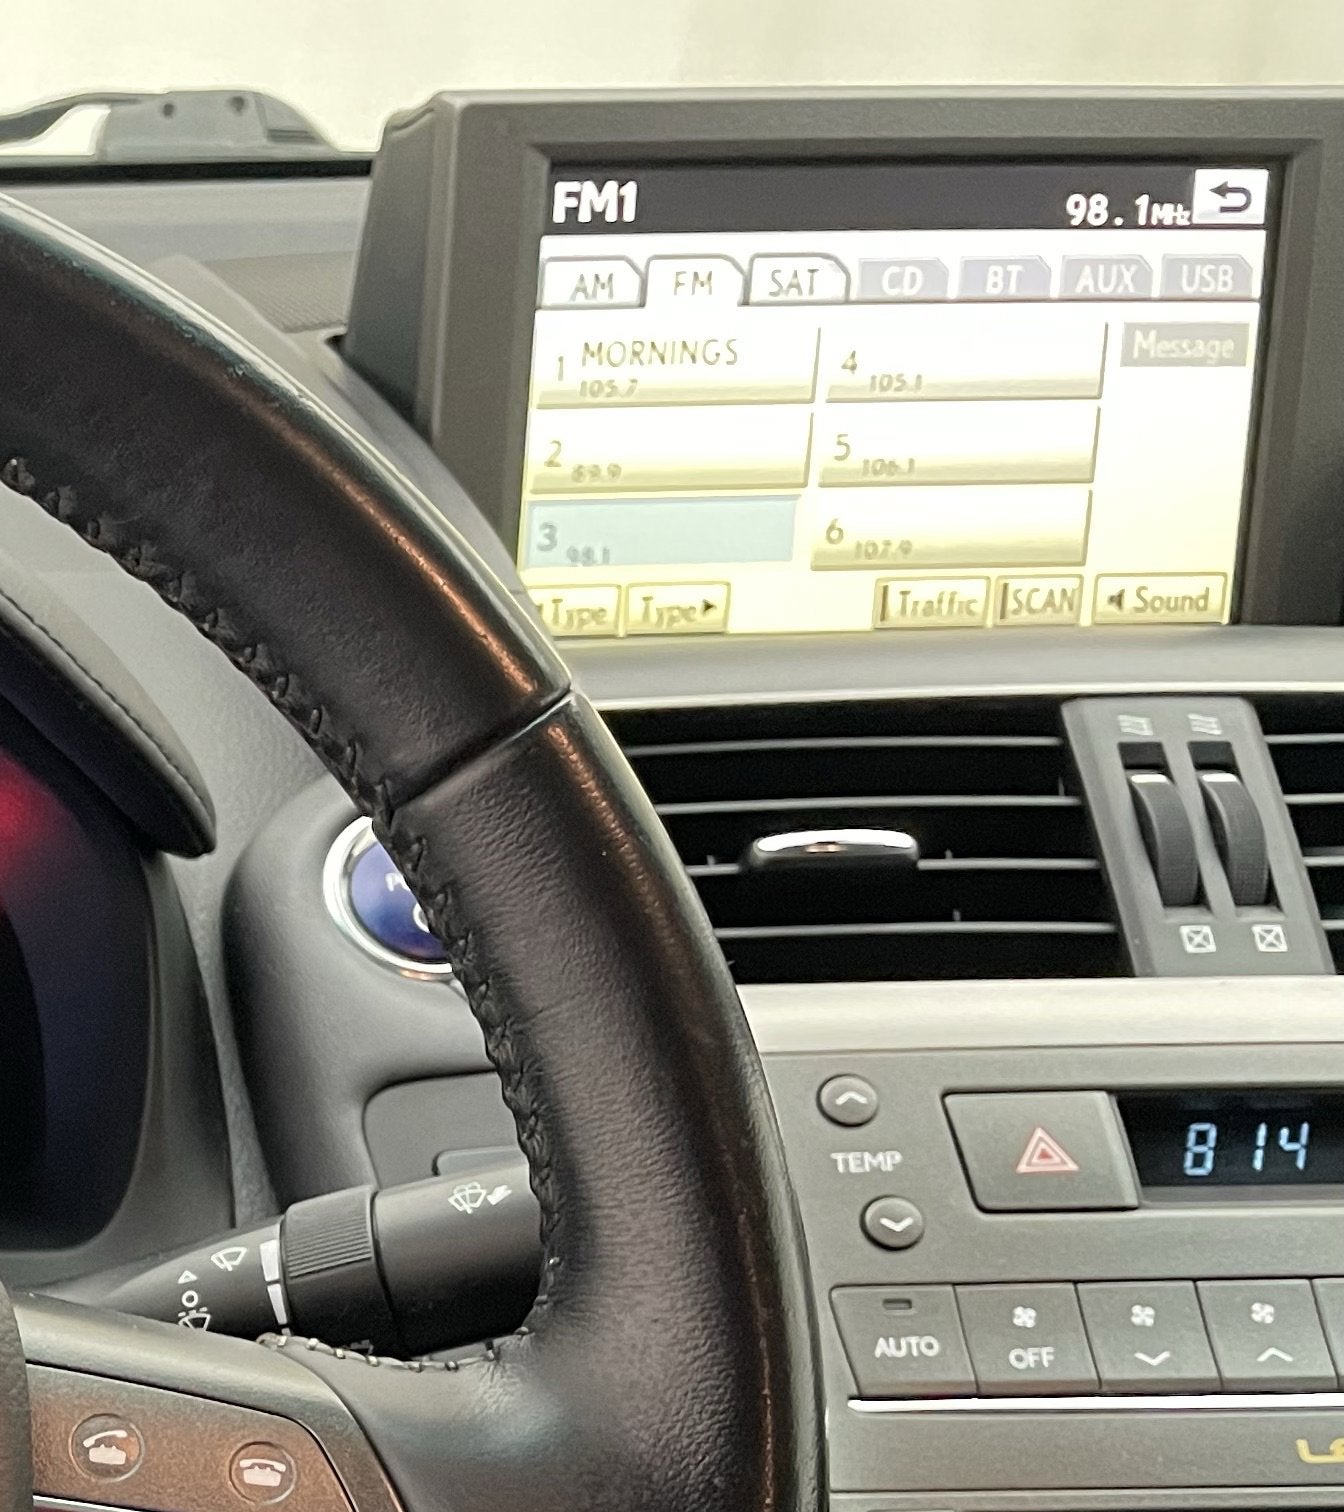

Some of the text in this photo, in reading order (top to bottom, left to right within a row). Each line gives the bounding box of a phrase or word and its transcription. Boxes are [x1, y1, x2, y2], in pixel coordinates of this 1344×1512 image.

[553, 180, 638, 223] FM1
[570, 273, 614, 301] AM
[673, 270, 713, 296] FM
[768, 268, 820, 297] SAT
[881, 265, 924, 296] CD
[985, 265, 1023, 295] BT
[1075, 264, 1138, 294] AUX
[1180, 264, 1234, 294] USB
[581, 338, 738, 367] MORNINGS
[1132, 329, 1235, 363] Message
[841, 350, 858, 375] 4
[543, 440, 562, 468] 2
[834, 434, 851, 461] 5
[537, 521, 558, 552] 3
[825, 518, 844, 545] 6
[641, 596, 697, 629] Type
[1011, 587, 1079, 615] SCAN
[1133, 585, 1210, 614] Sound
[551, 598, 608, 631] Type
[831, 1150, 904, 1174] TEMP
[873, 1335, 941, 1359] AUTO
[1007, 1345, 1056, 1370] OFF
